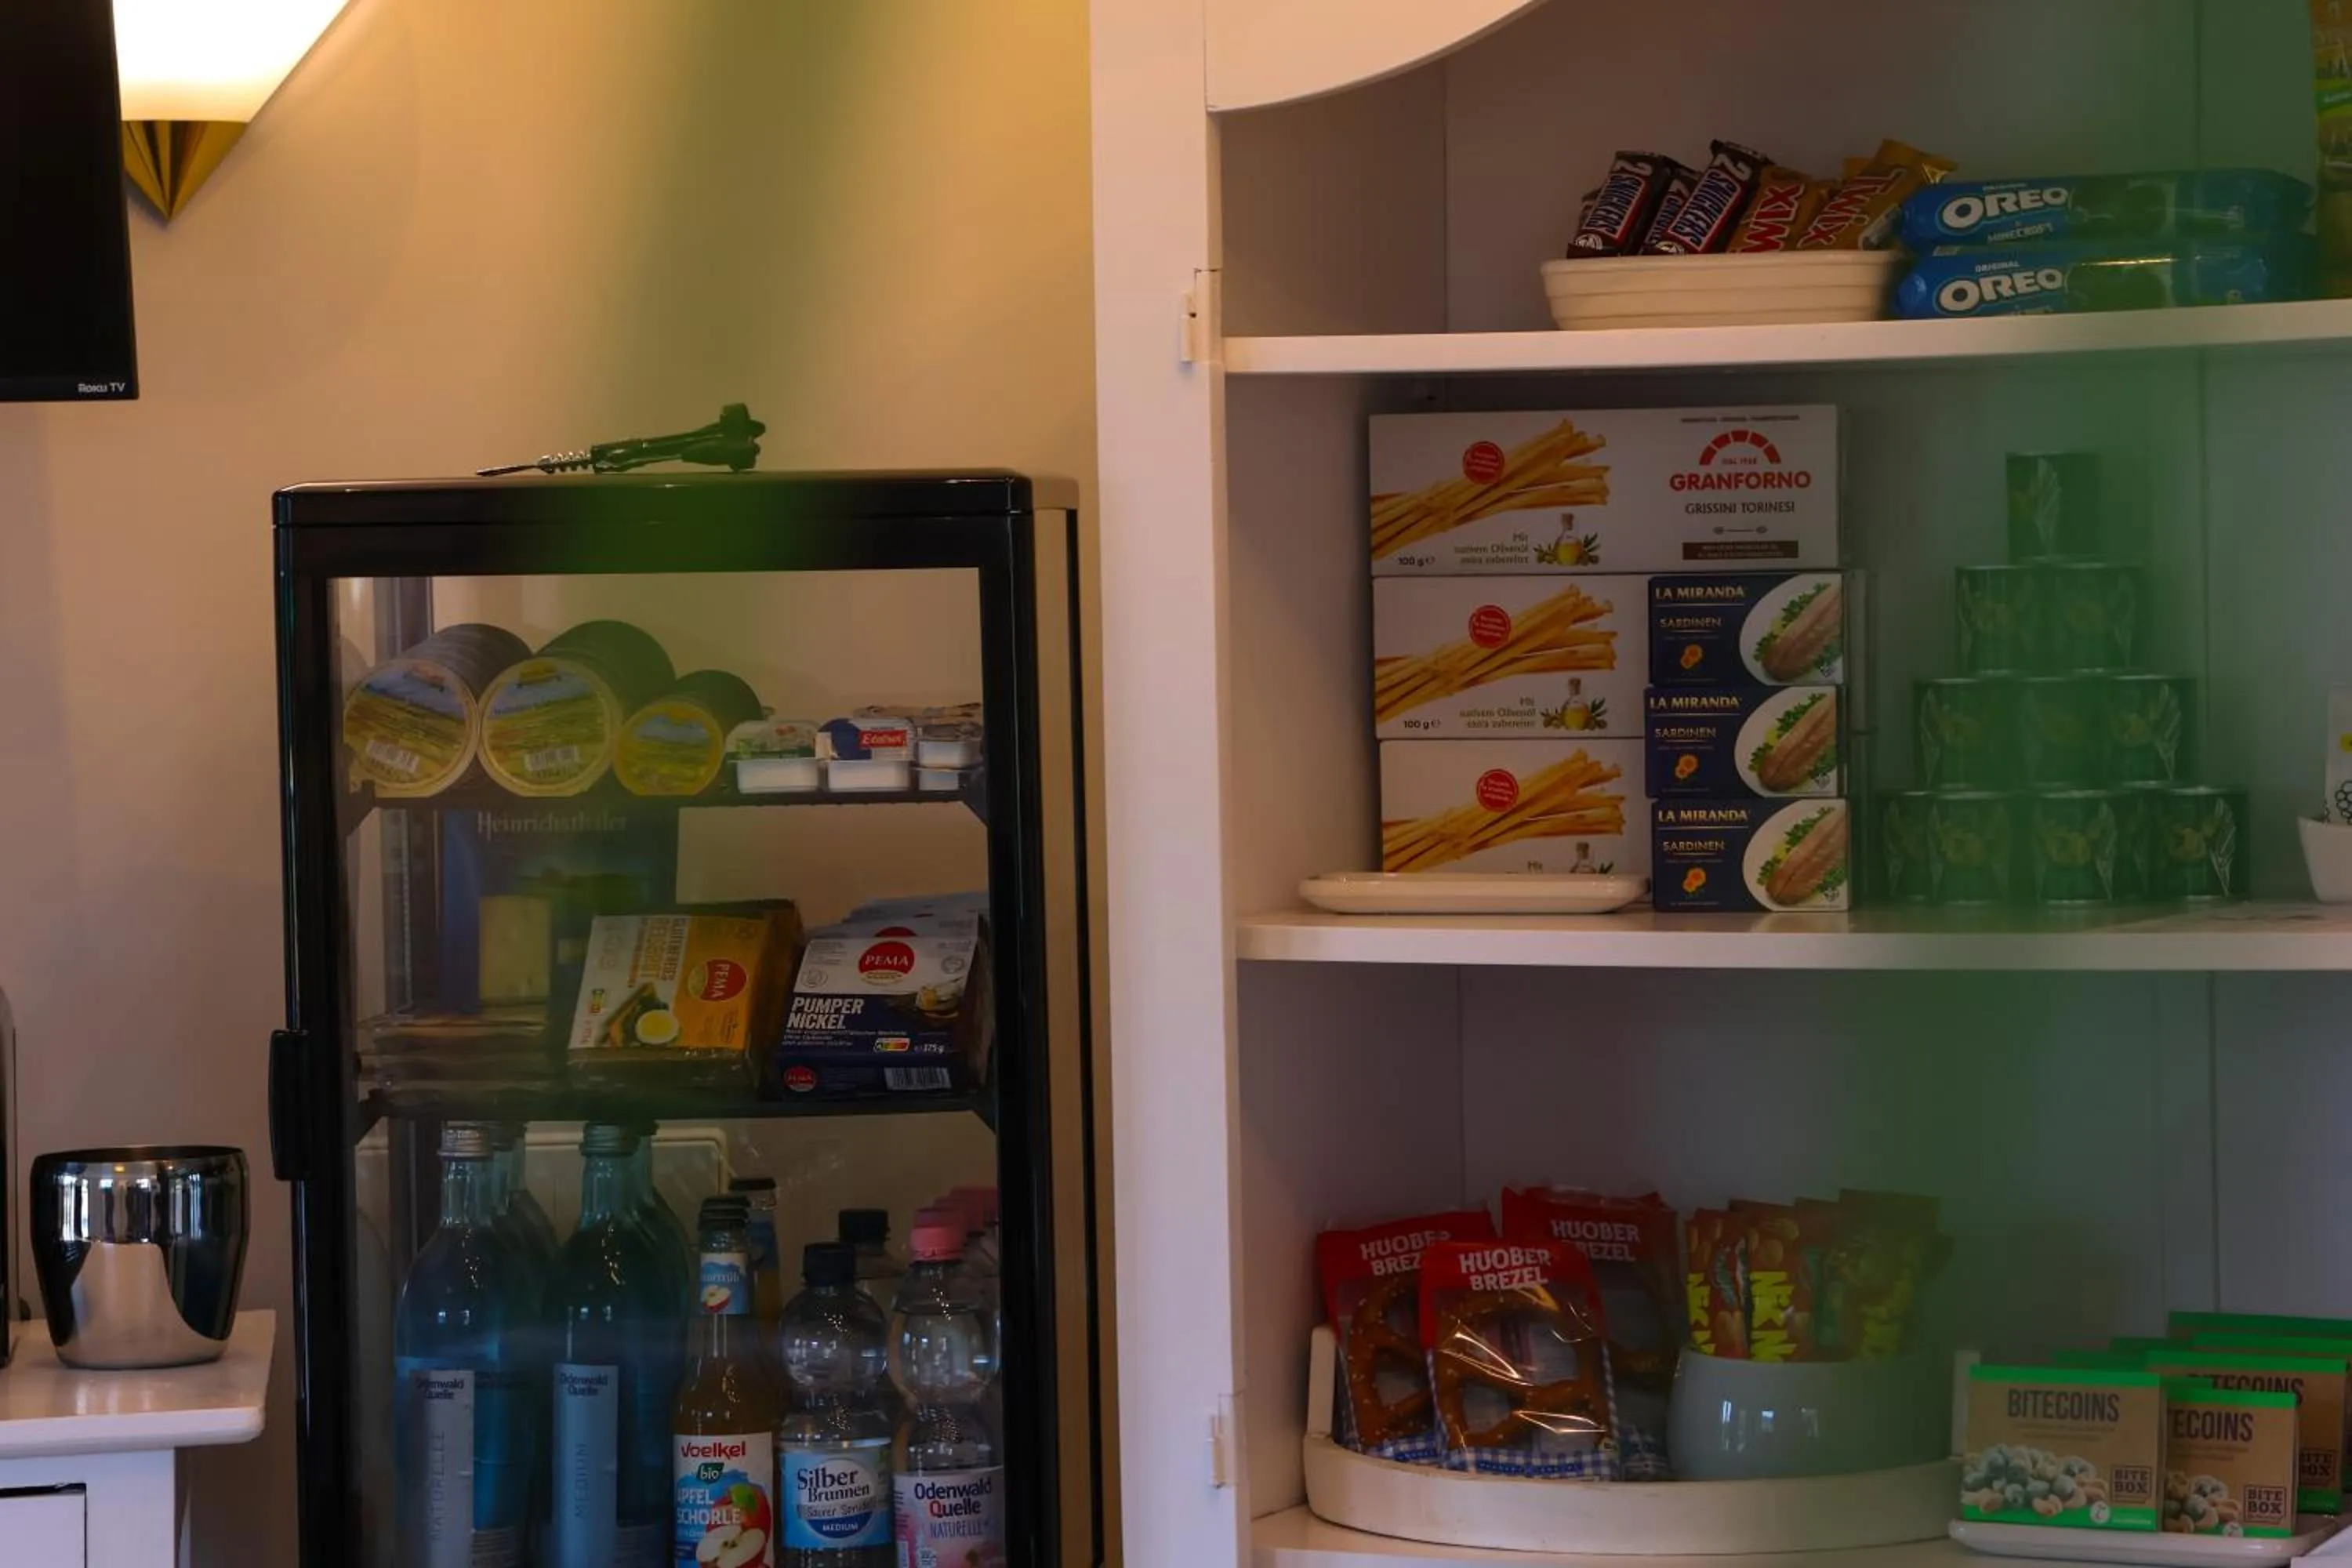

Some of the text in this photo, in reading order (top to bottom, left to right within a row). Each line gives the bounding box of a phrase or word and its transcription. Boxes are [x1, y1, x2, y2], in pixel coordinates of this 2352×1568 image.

[1585, 172, 1643, 237] SNICKERS
[1671, 170, 1740, 247] SNICKERS
[1797, 168, 1907, 249] TWIX
[1941, 187, 2069, 230] OREO
[1734, 183, 1805, 252] WIX
[1939, 267, 2063, 312] OREO
[78, 383, 126, 393] Roku TV
[1669, 471, 1813, 492] GRANFORNO
[1685, 500, 1795, 514] GRISSINI TORINESI
[1399, 556, 1425, 568] 100 g
[1656, 585, 1745, 601] LA MIRANDA
[1659, 616, 1722, 629] SARDINEN
[1650, 695, 1740, 710] LA MIRANDA
[1403, 720, 1430, 731] 100 g
[1653, 725, 1718, 739] SARDINEN
[1658, 808, 1749, 823] LA MIRANDA
[1662, 840, 1726, 852] SARDINEN
[865, 955, 909, 966] PEMA
[711, 964, 731, 998] PEMA
[791, 996, 865, 1014] PUMPER
[786, 1012, 847, 1029] NICKEL
[1549, 1218, 1642, 1243] HUOBER
[1458, 1246, 1552, 1274] HUOBER
[1576, 1240, 1638, 1262] EZEL
[1370, 1252, 1421, 1276] BREZ
[1469, 1266, 1549, 1291] BREZEL
[2007, 1388, 2121, 1422] BITECOINS
[2167, 1409, 2254, 1443] ECOINS
[681, 1440, 747, 1461] Voelkel
[700, 1465, 720, 1480] bio
[797, 1467, 858, 1490] Silber
[2114, 1468, 2148, 1482] BITE
[808, 1484, 870, 1503] Brunnen
[914, 1477, 993, 1500] Odenwald
[2114, 1481, 2147, 1495] BOX
[2247, 1489, 2283, 1502] BITE
[928, 1497, 982, 1518] Quelle
[2247, 1501, 2283, 1516] BOX
[822, 1523, 858, 1532] MEDIUM
[930, 1519, 984, 1538] NATURELLE
